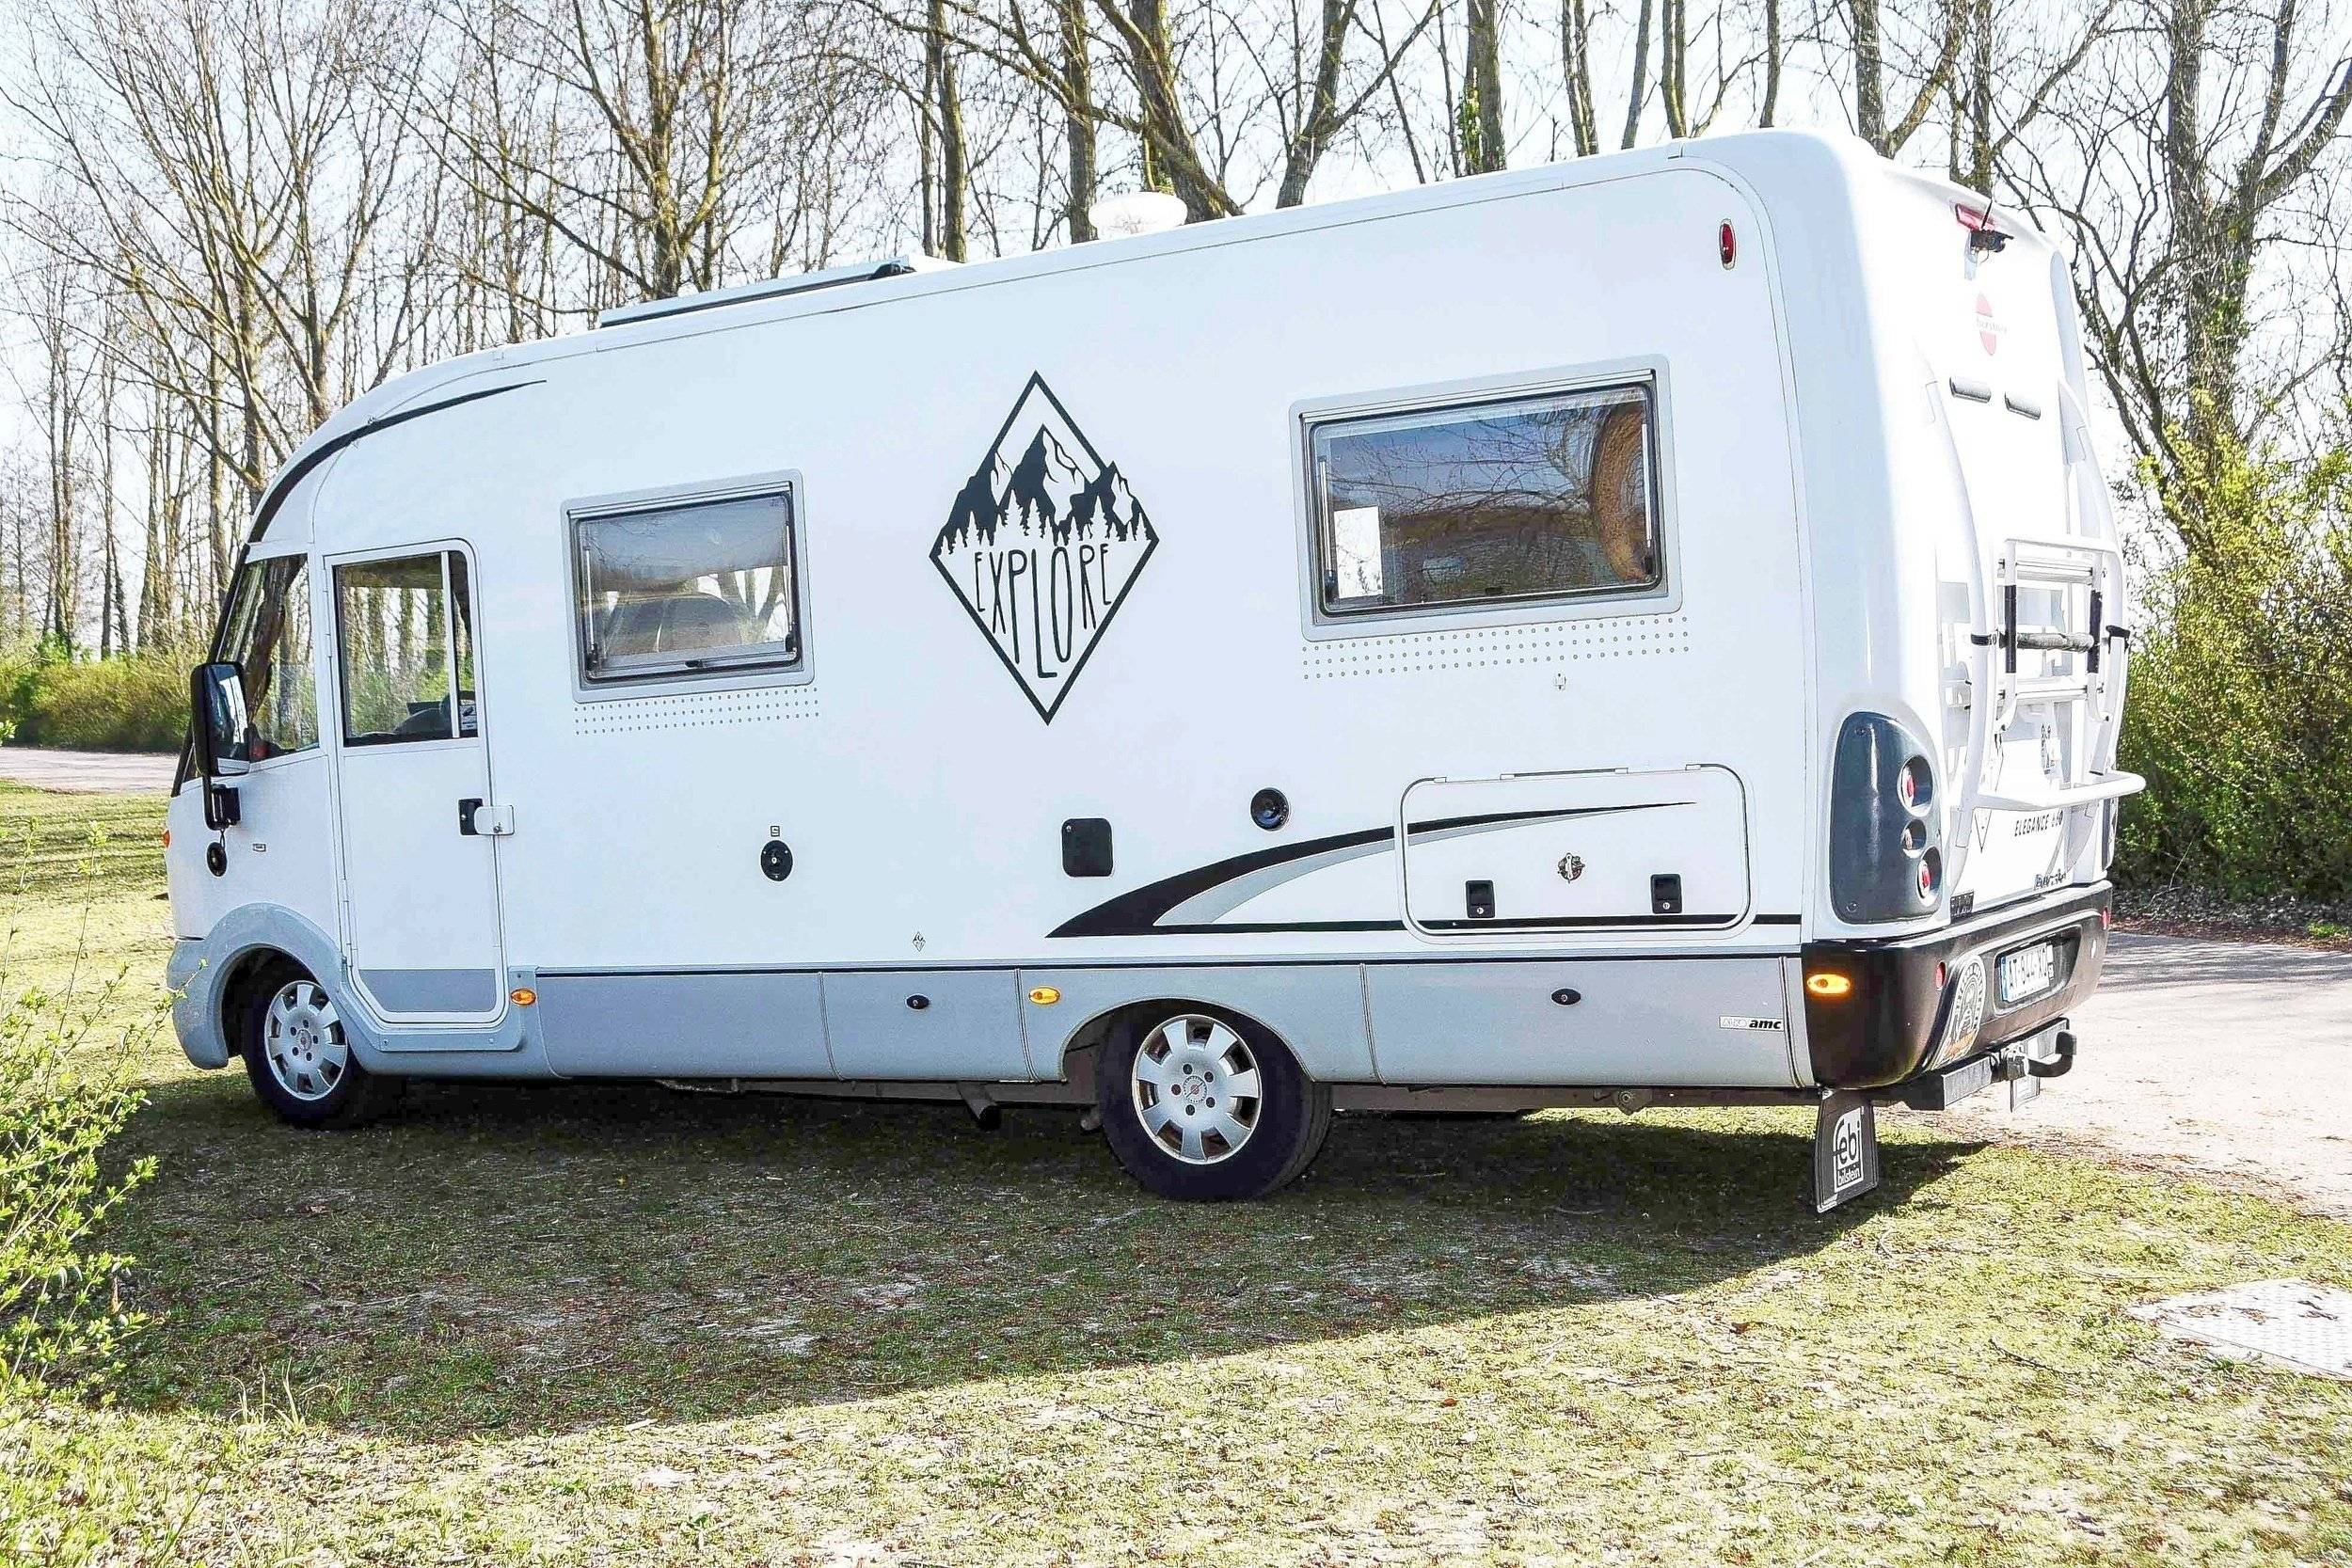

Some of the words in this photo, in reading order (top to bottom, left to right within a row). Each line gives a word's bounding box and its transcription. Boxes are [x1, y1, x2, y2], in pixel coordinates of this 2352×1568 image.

[974, 543, 1112, 678] EXPLORE
[2014, 814, 2049, 836] ELEGANCE
[1749, 1020, 1782, 1030] amc
[1832, 1117, 1861, 1164] febi
[1837, 1164, 1862, 1186] bilstein
